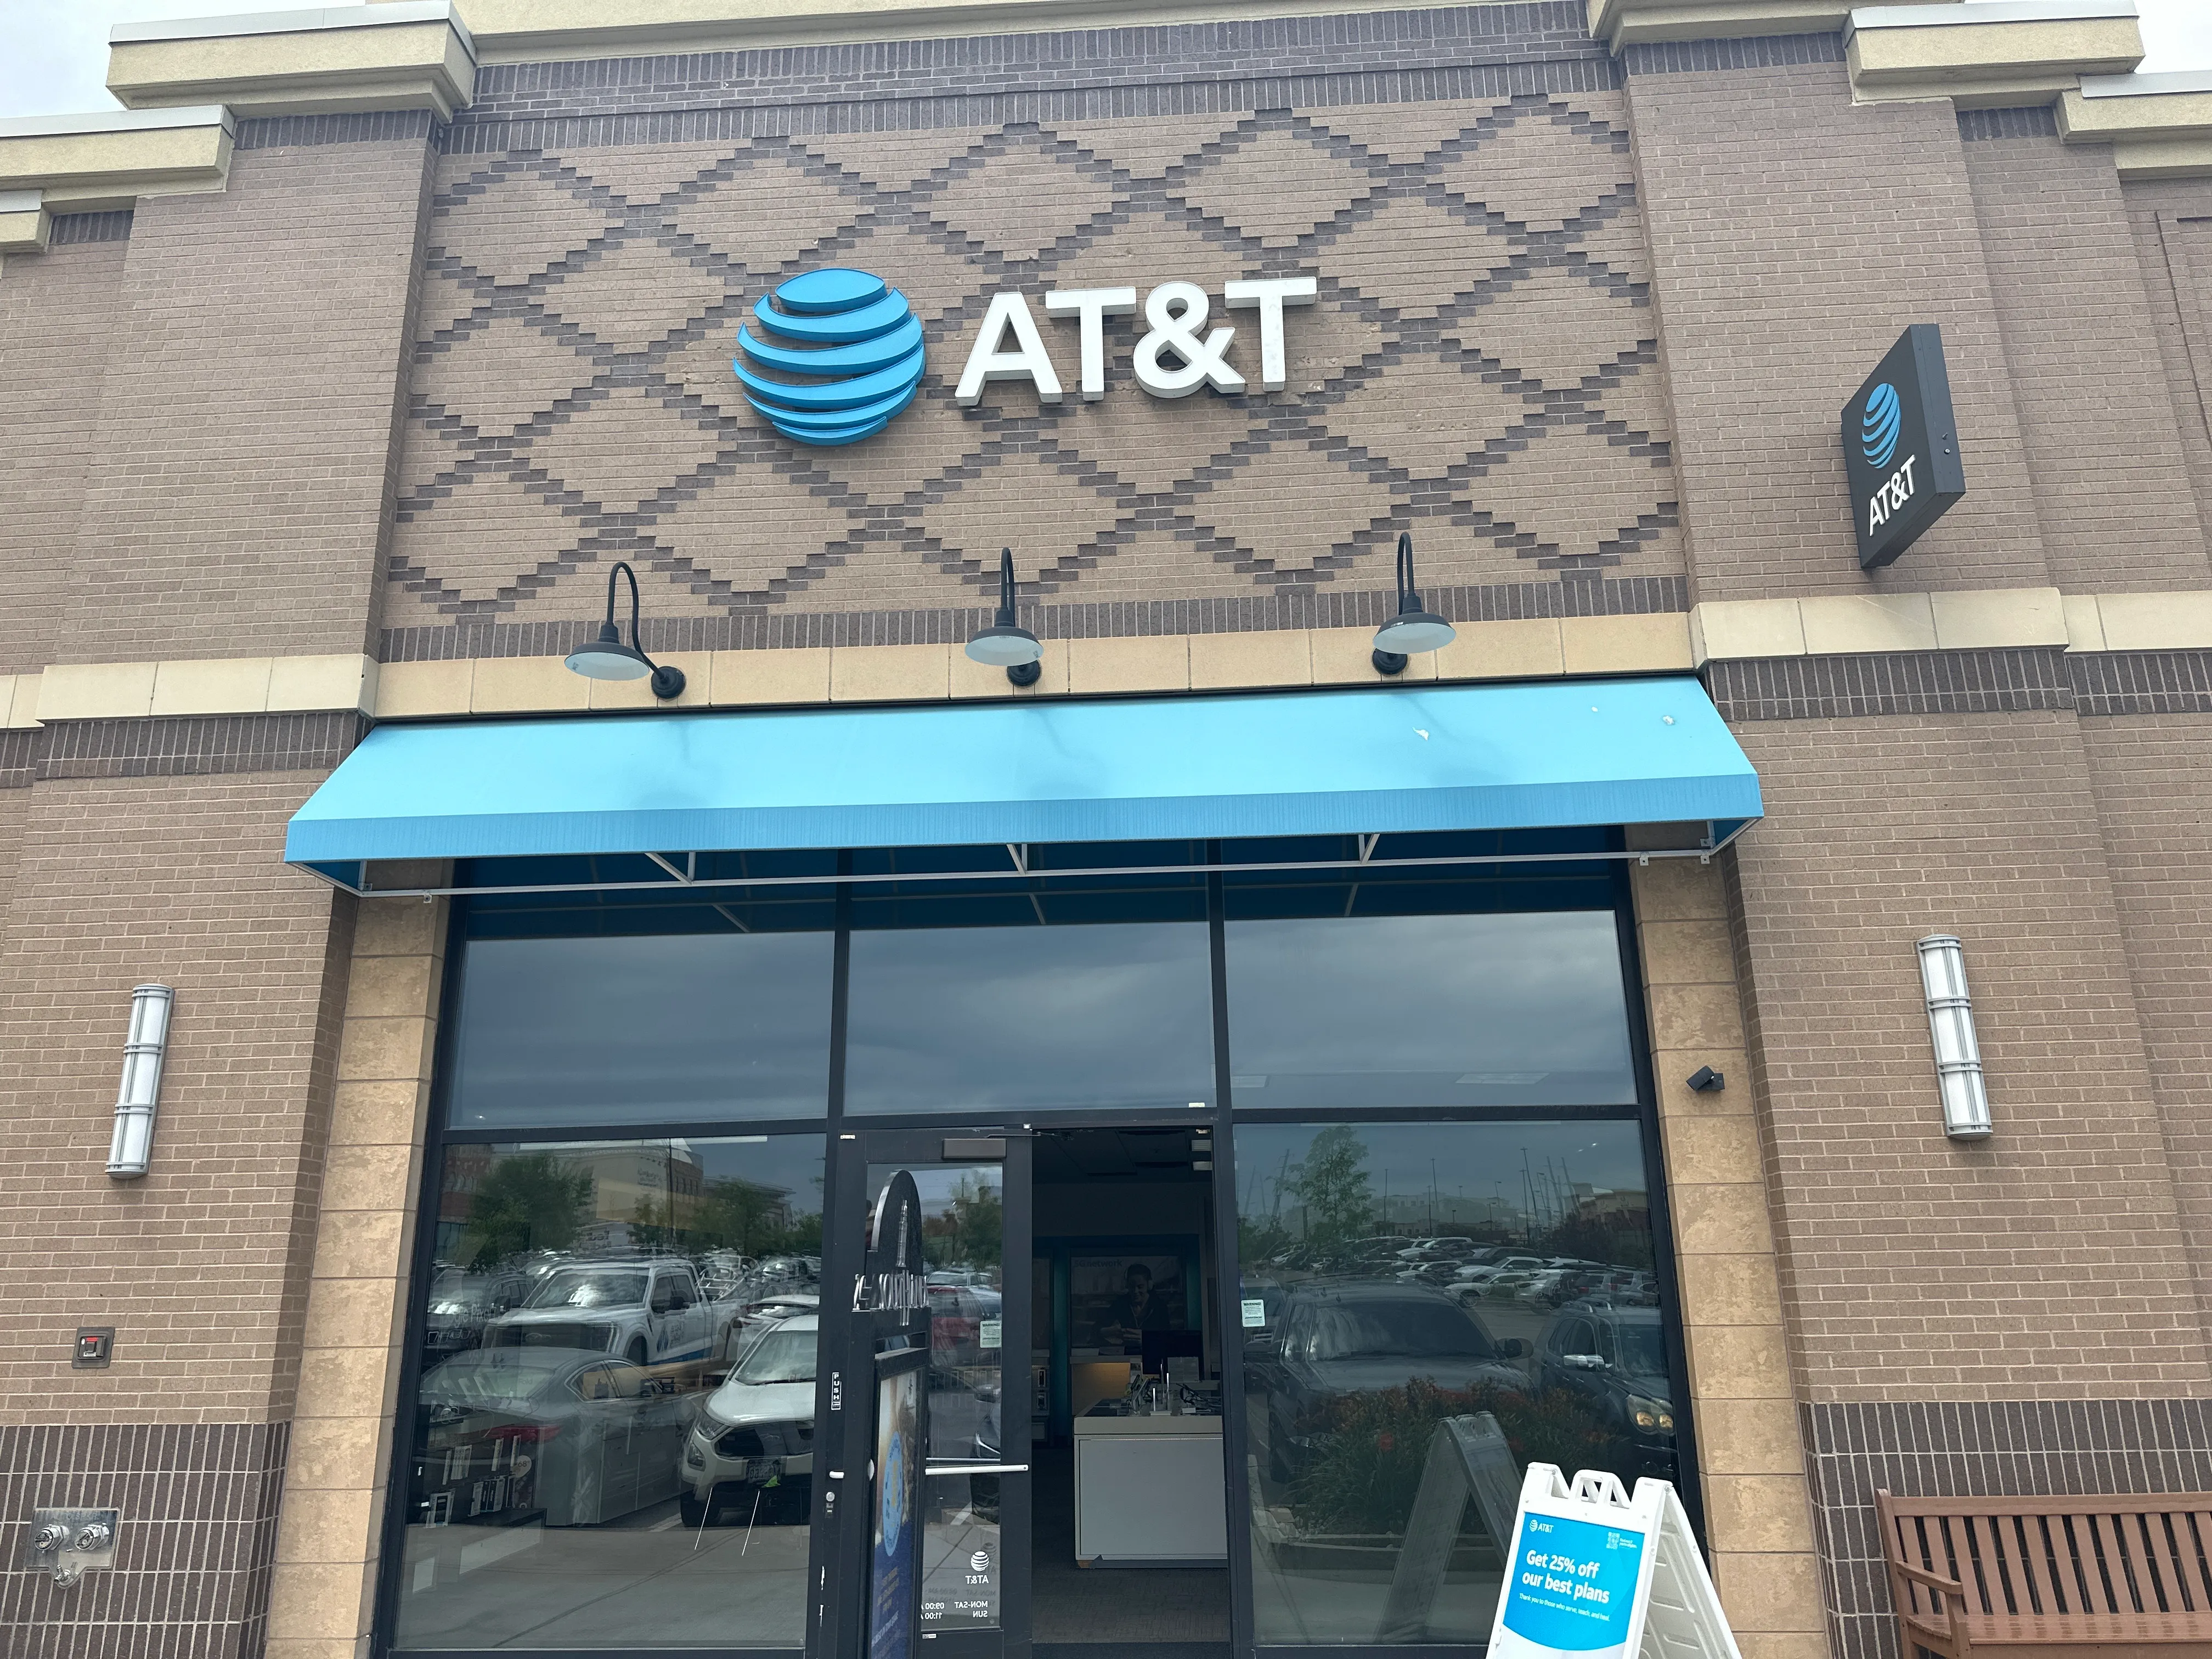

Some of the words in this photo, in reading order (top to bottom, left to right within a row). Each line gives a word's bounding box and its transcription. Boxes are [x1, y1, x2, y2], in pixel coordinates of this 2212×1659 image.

[955, 276, 1317, 407] AT&T
[1869, 454, 1916, 536] AT&T
[1537, 1522, 1554, 1533] AT&T
[1527, 1549, 1548, 1568] Get
[1549, 1554, 1576, 1574] 25%
[1578, 1561, 1600, 1579] off
[1519, 1593, 1531, 1601] Thank
[1544, 1599, 1555, 1608] those
[1522, 1572, 1543, 1587] our
[1544, 1572, 1573, 1595] best
[1573, 1581, 1610, 1604] plans
